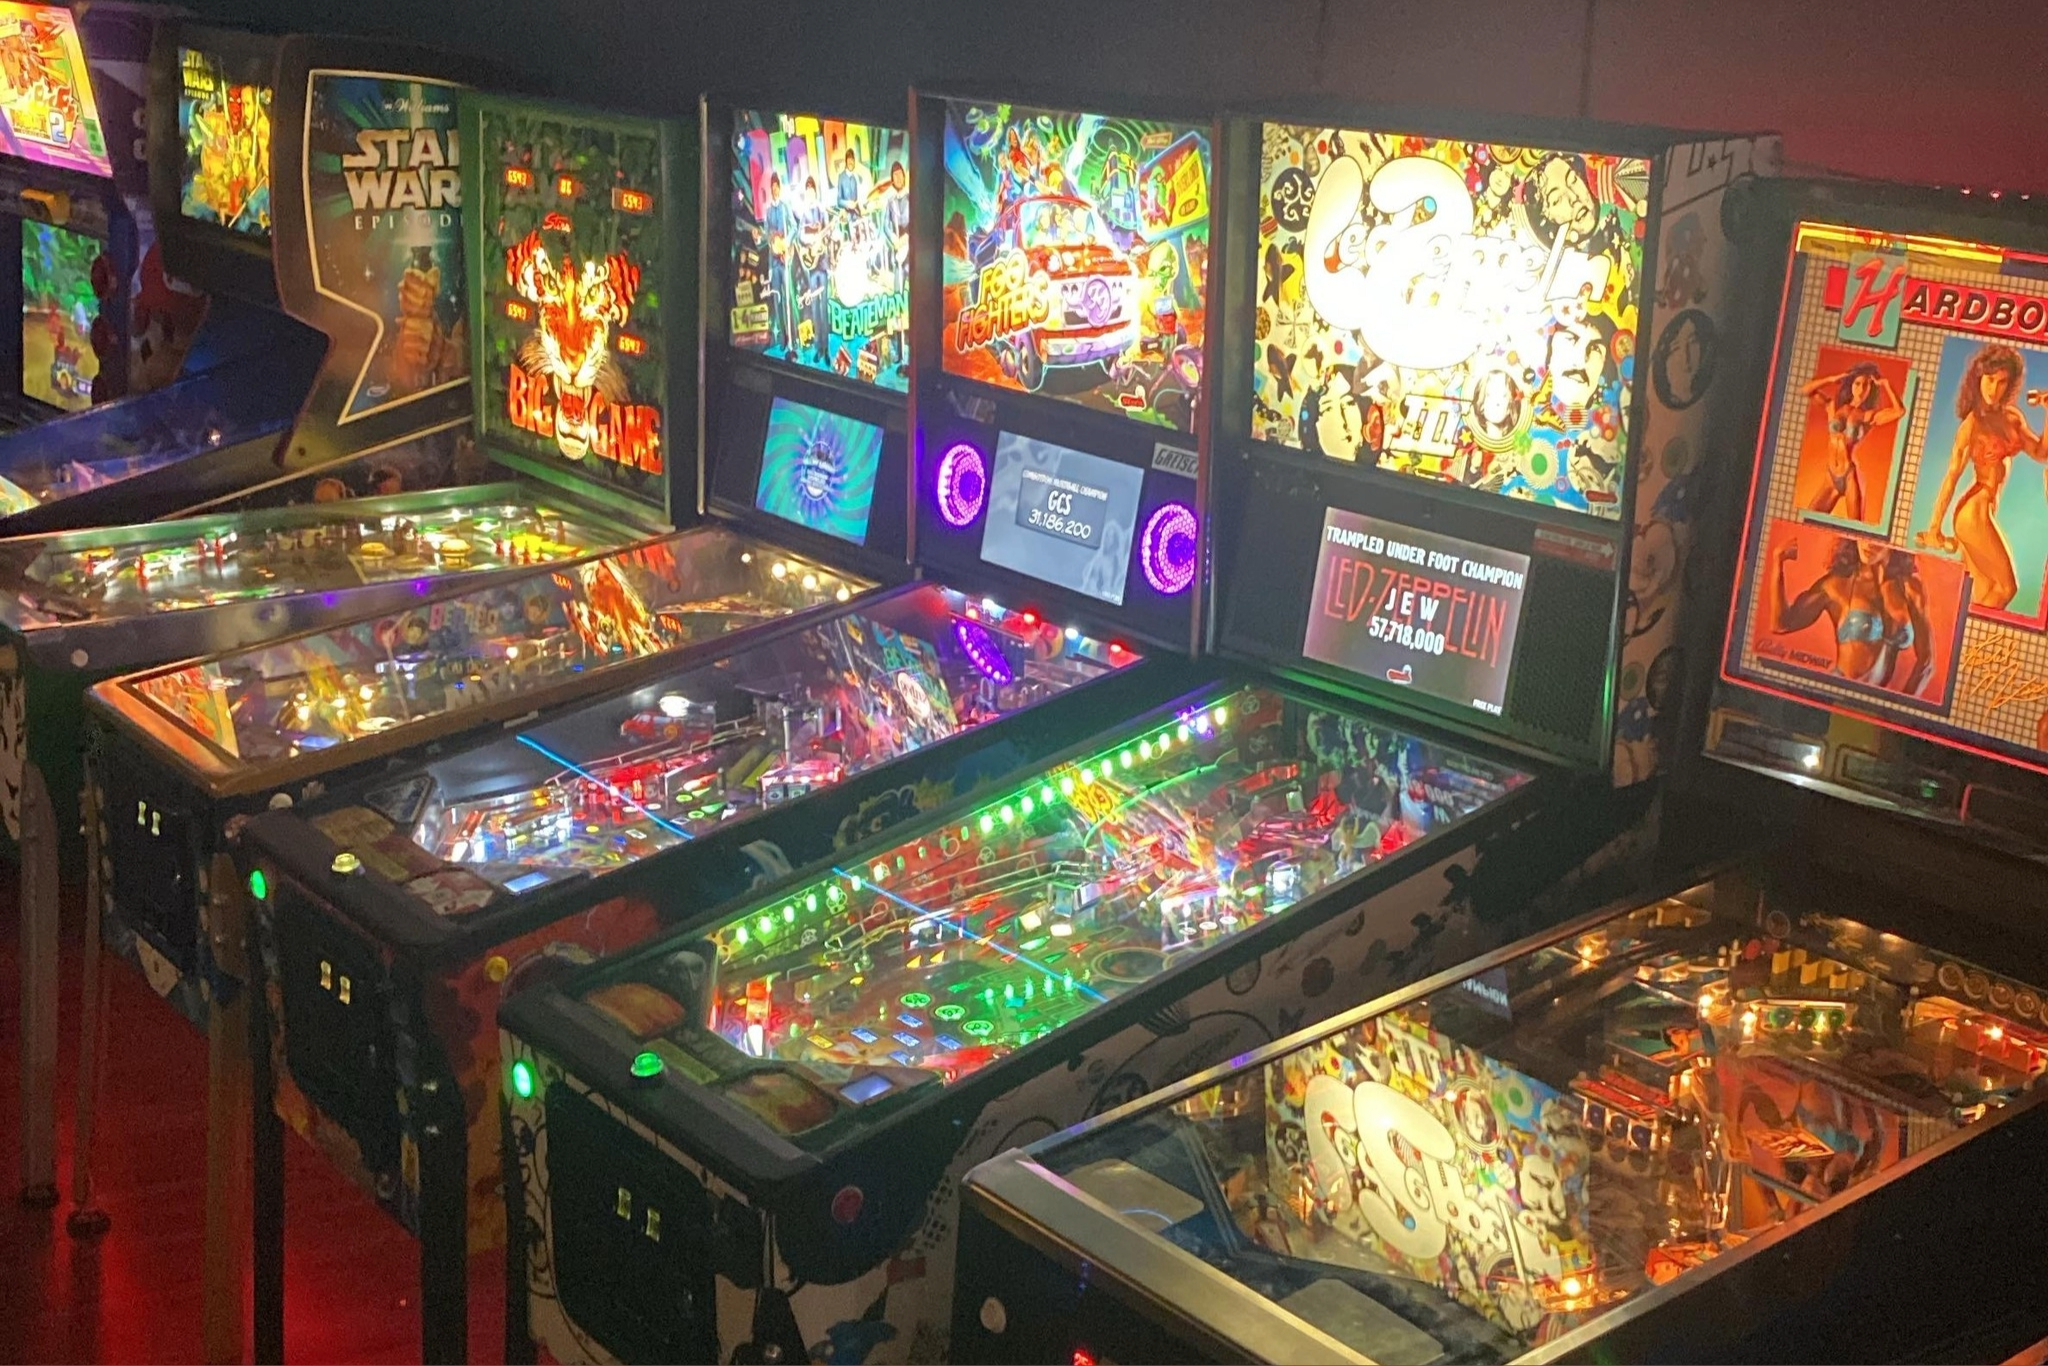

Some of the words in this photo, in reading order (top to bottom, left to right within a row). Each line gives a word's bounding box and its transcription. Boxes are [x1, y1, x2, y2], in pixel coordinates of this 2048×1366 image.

[354, 213, 463, 230] EPISOD
[979, 250, 1028, 304] FOO
[1841, 257, 2048, 338] HARDBO
[956, 271, 1050, 352] FIGHTERS
[509, 363, 554, 438] BIG
[589, 391, 663, 476] GAME
[1047, 490, 1073, 516] GCS
[1326, 525, 1384, 554] TRAMPLED
[1386, 540, 1426, 566] UNDER
[1427, 550, 1460, 574] FOOT
[1461, 559, 1524, 590] CHAMPION
[1369, 615, 1445, 655] 57,718,000
[1472, 698, 1487, 711] FREE
[1487, 702, 1503, 716] PLAY
